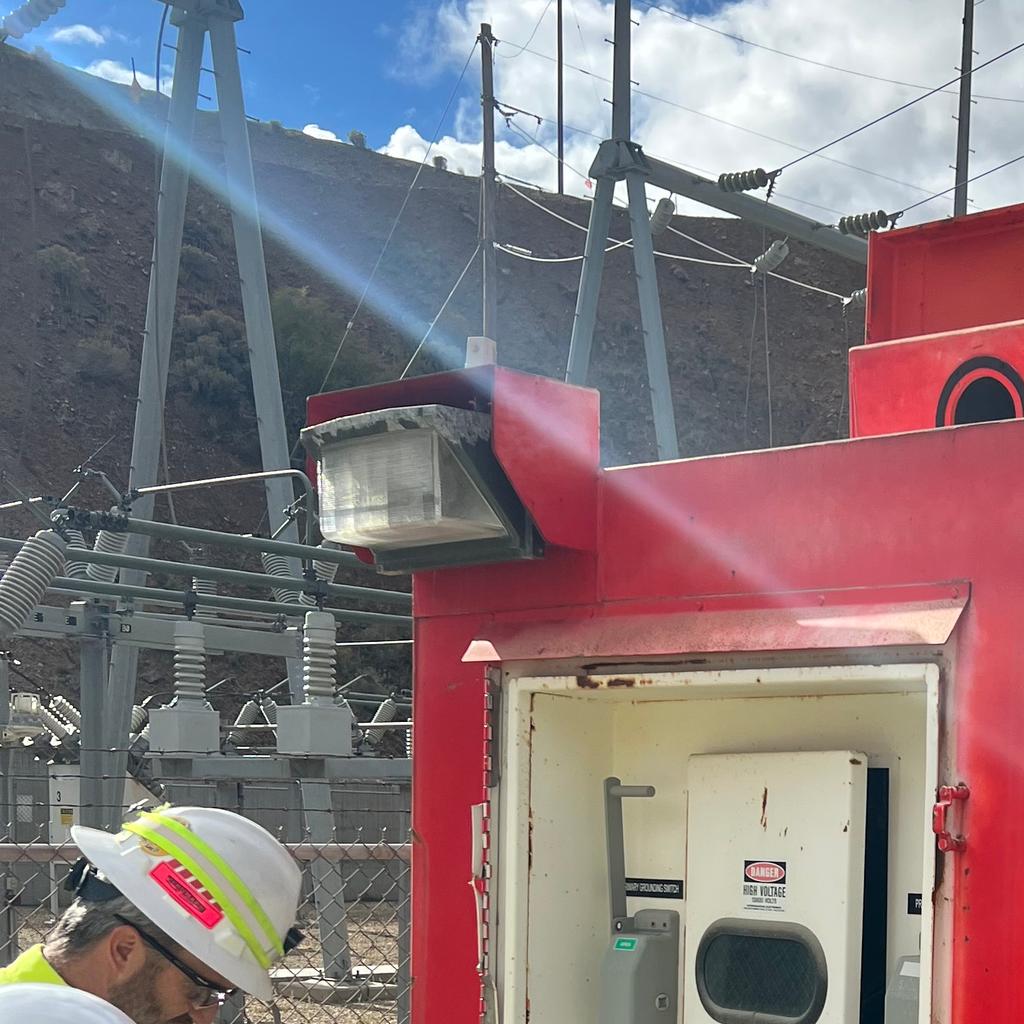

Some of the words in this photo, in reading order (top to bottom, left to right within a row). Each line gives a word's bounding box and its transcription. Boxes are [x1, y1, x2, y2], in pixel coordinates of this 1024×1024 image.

[57, 791, 61, 802] 3
[751, 867, 779, 878] DANGER
[743, 885, 758, 896] HIGH
[760, 886, 786, 898] VOLTAGE
